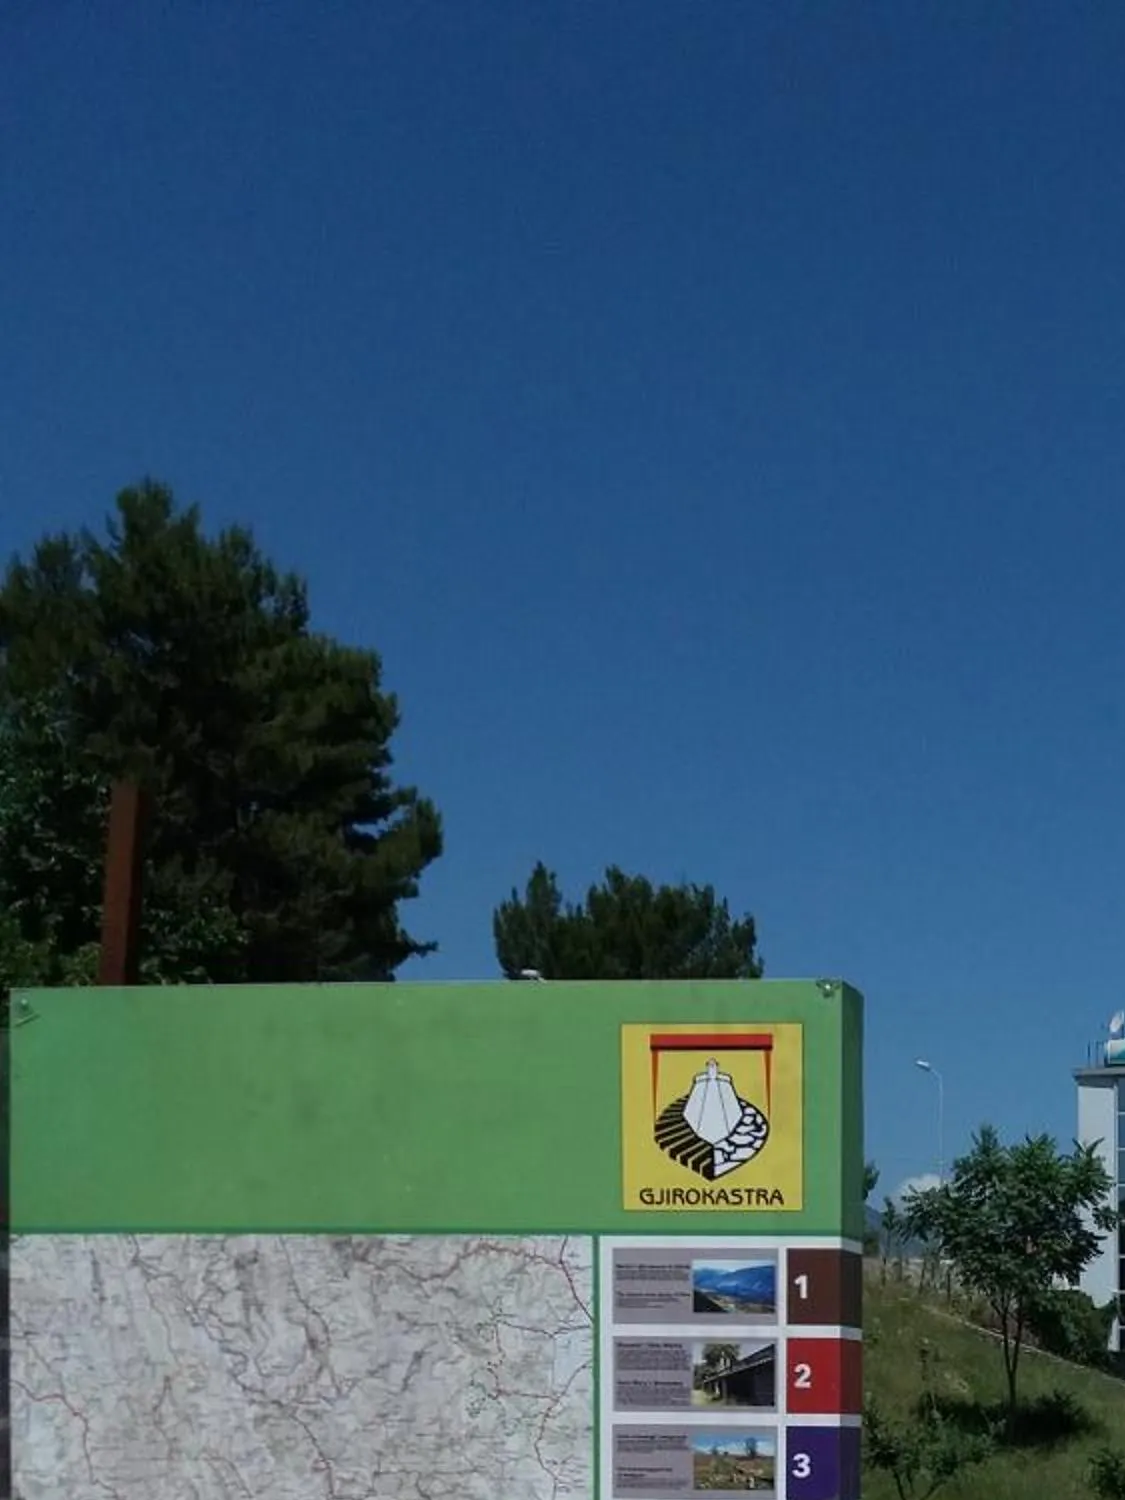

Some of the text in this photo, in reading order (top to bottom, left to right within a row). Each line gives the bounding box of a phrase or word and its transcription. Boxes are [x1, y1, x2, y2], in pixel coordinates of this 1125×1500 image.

[639, 1187, 785, 1206] GJIROKASTRA
[794, 1275, 808, 1299] 1
[794, 1363, 811, 1388] 2
[792, 1453, 811, 1478] 3
